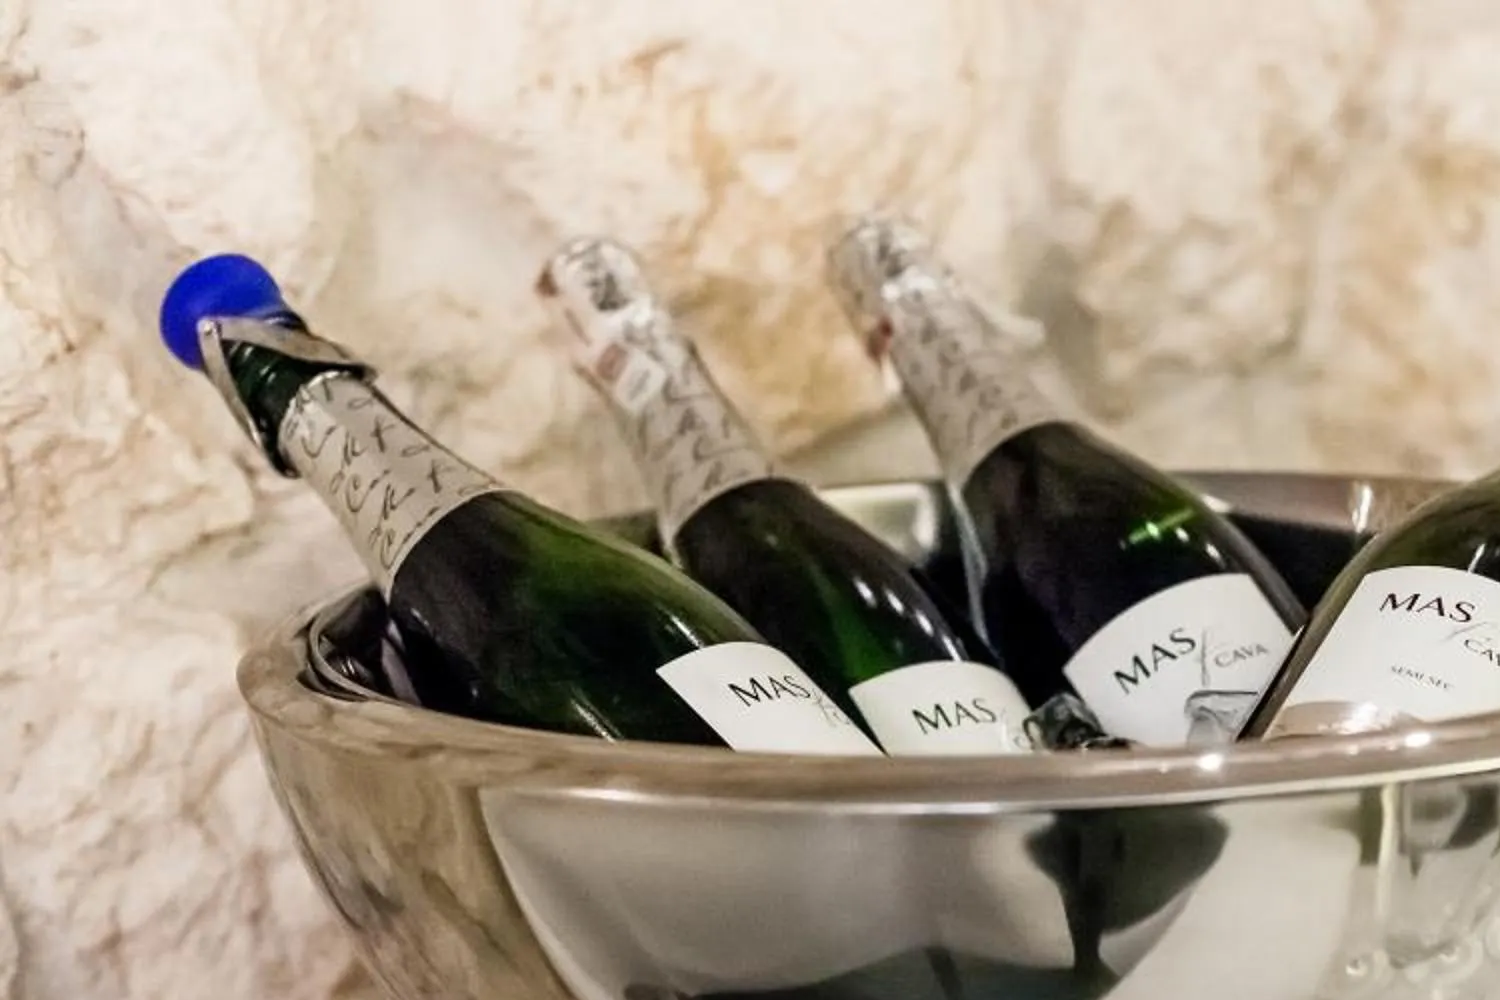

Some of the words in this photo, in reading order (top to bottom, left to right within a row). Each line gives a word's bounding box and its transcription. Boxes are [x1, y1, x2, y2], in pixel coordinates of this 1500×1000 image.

[1379, 592, 1475, 623] MAS
[1113, 627, 1197, 695] MAS
[1214, 643, 1269, 668] CAVA
[728, 675, 811, 707] MAS
[912, 698, 997, 735] MAS
